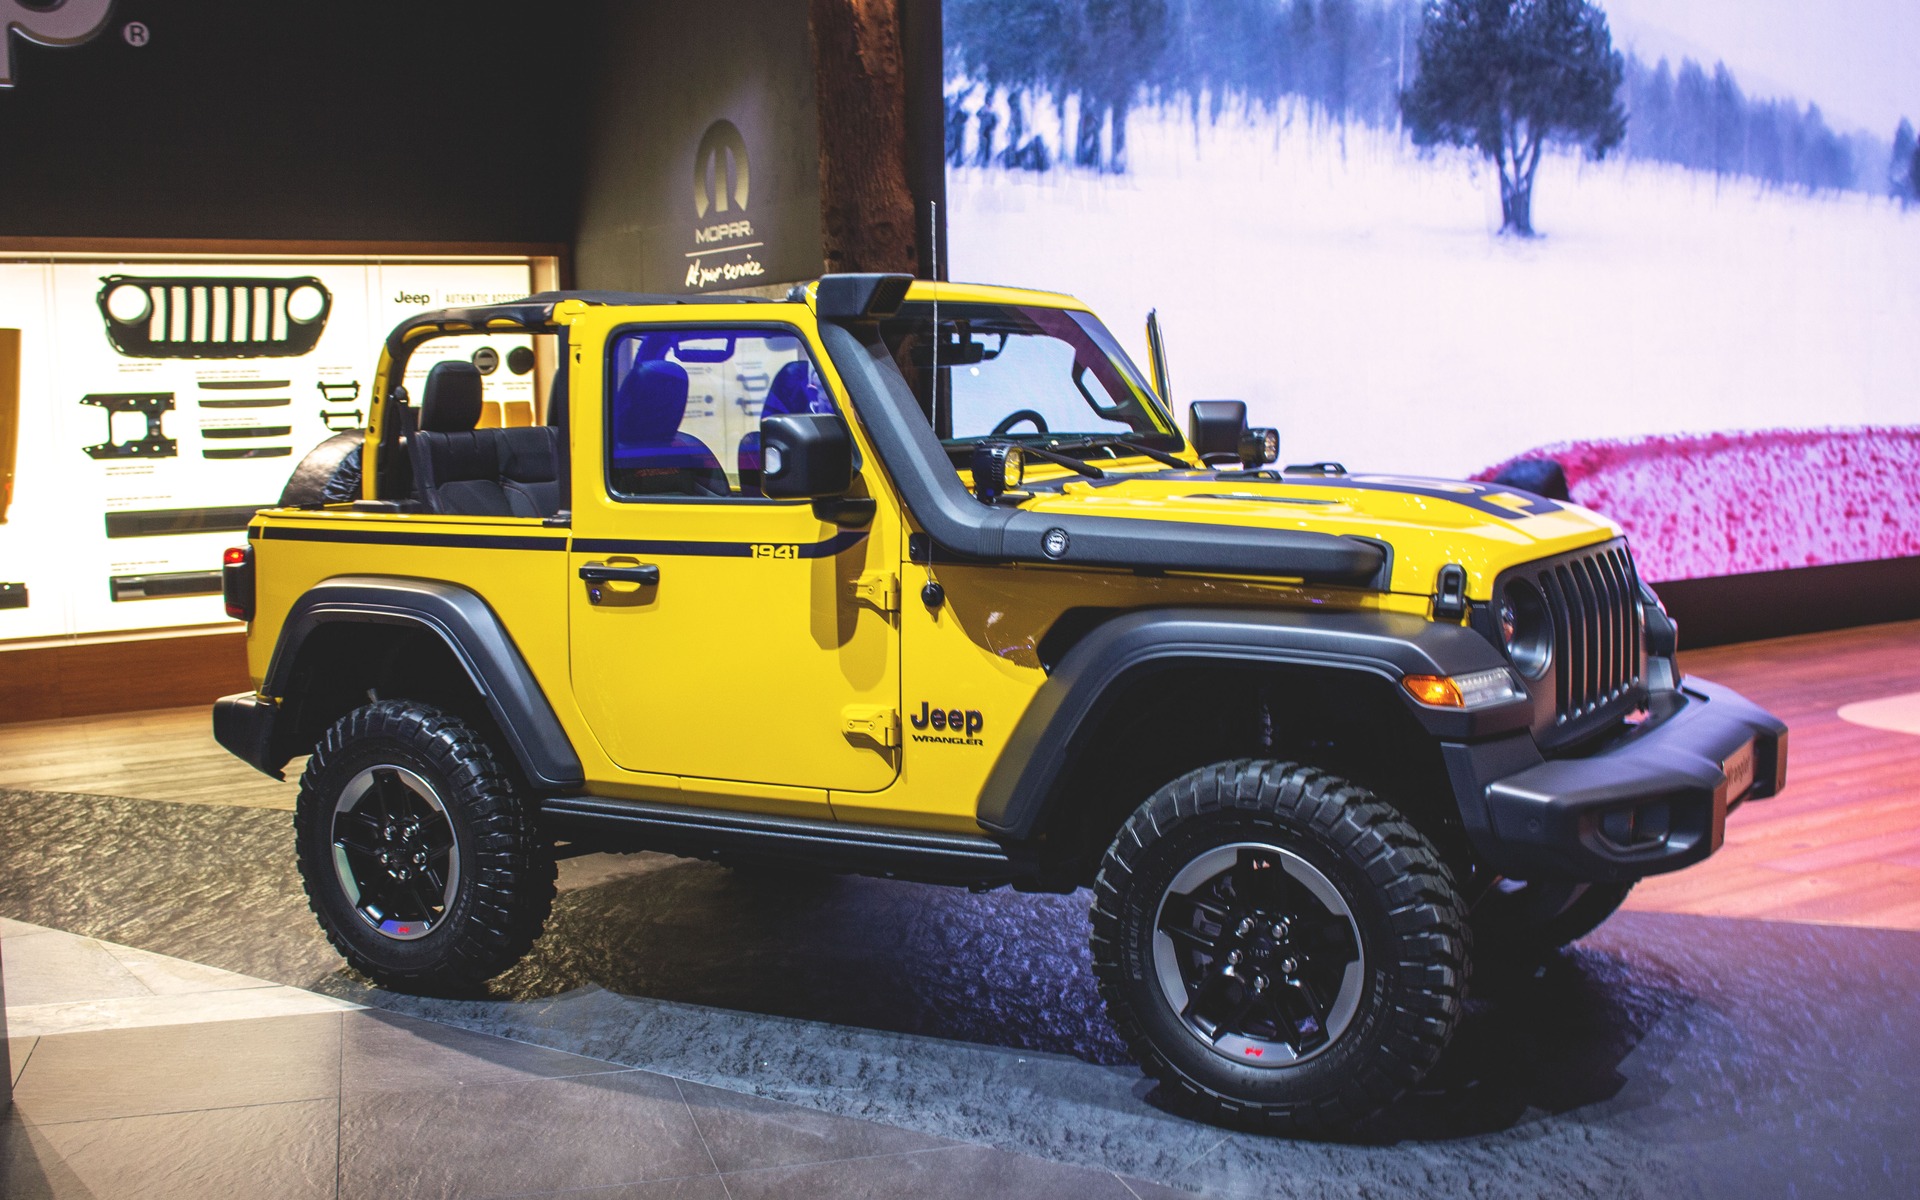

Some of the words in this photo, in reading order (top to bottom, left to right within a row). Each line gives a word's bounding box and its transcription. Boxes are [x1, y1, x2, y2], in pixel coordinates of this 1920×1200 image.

[695, 220, 751, 244] MOPAR
[723, 253, 765, 280] service
[394, 290, 431, 306] Jeep
[750, 544, 800, 560] 1941
[910, 701, 984, 738] Jeep
[911, 734, 984, 747] WRANGLER
